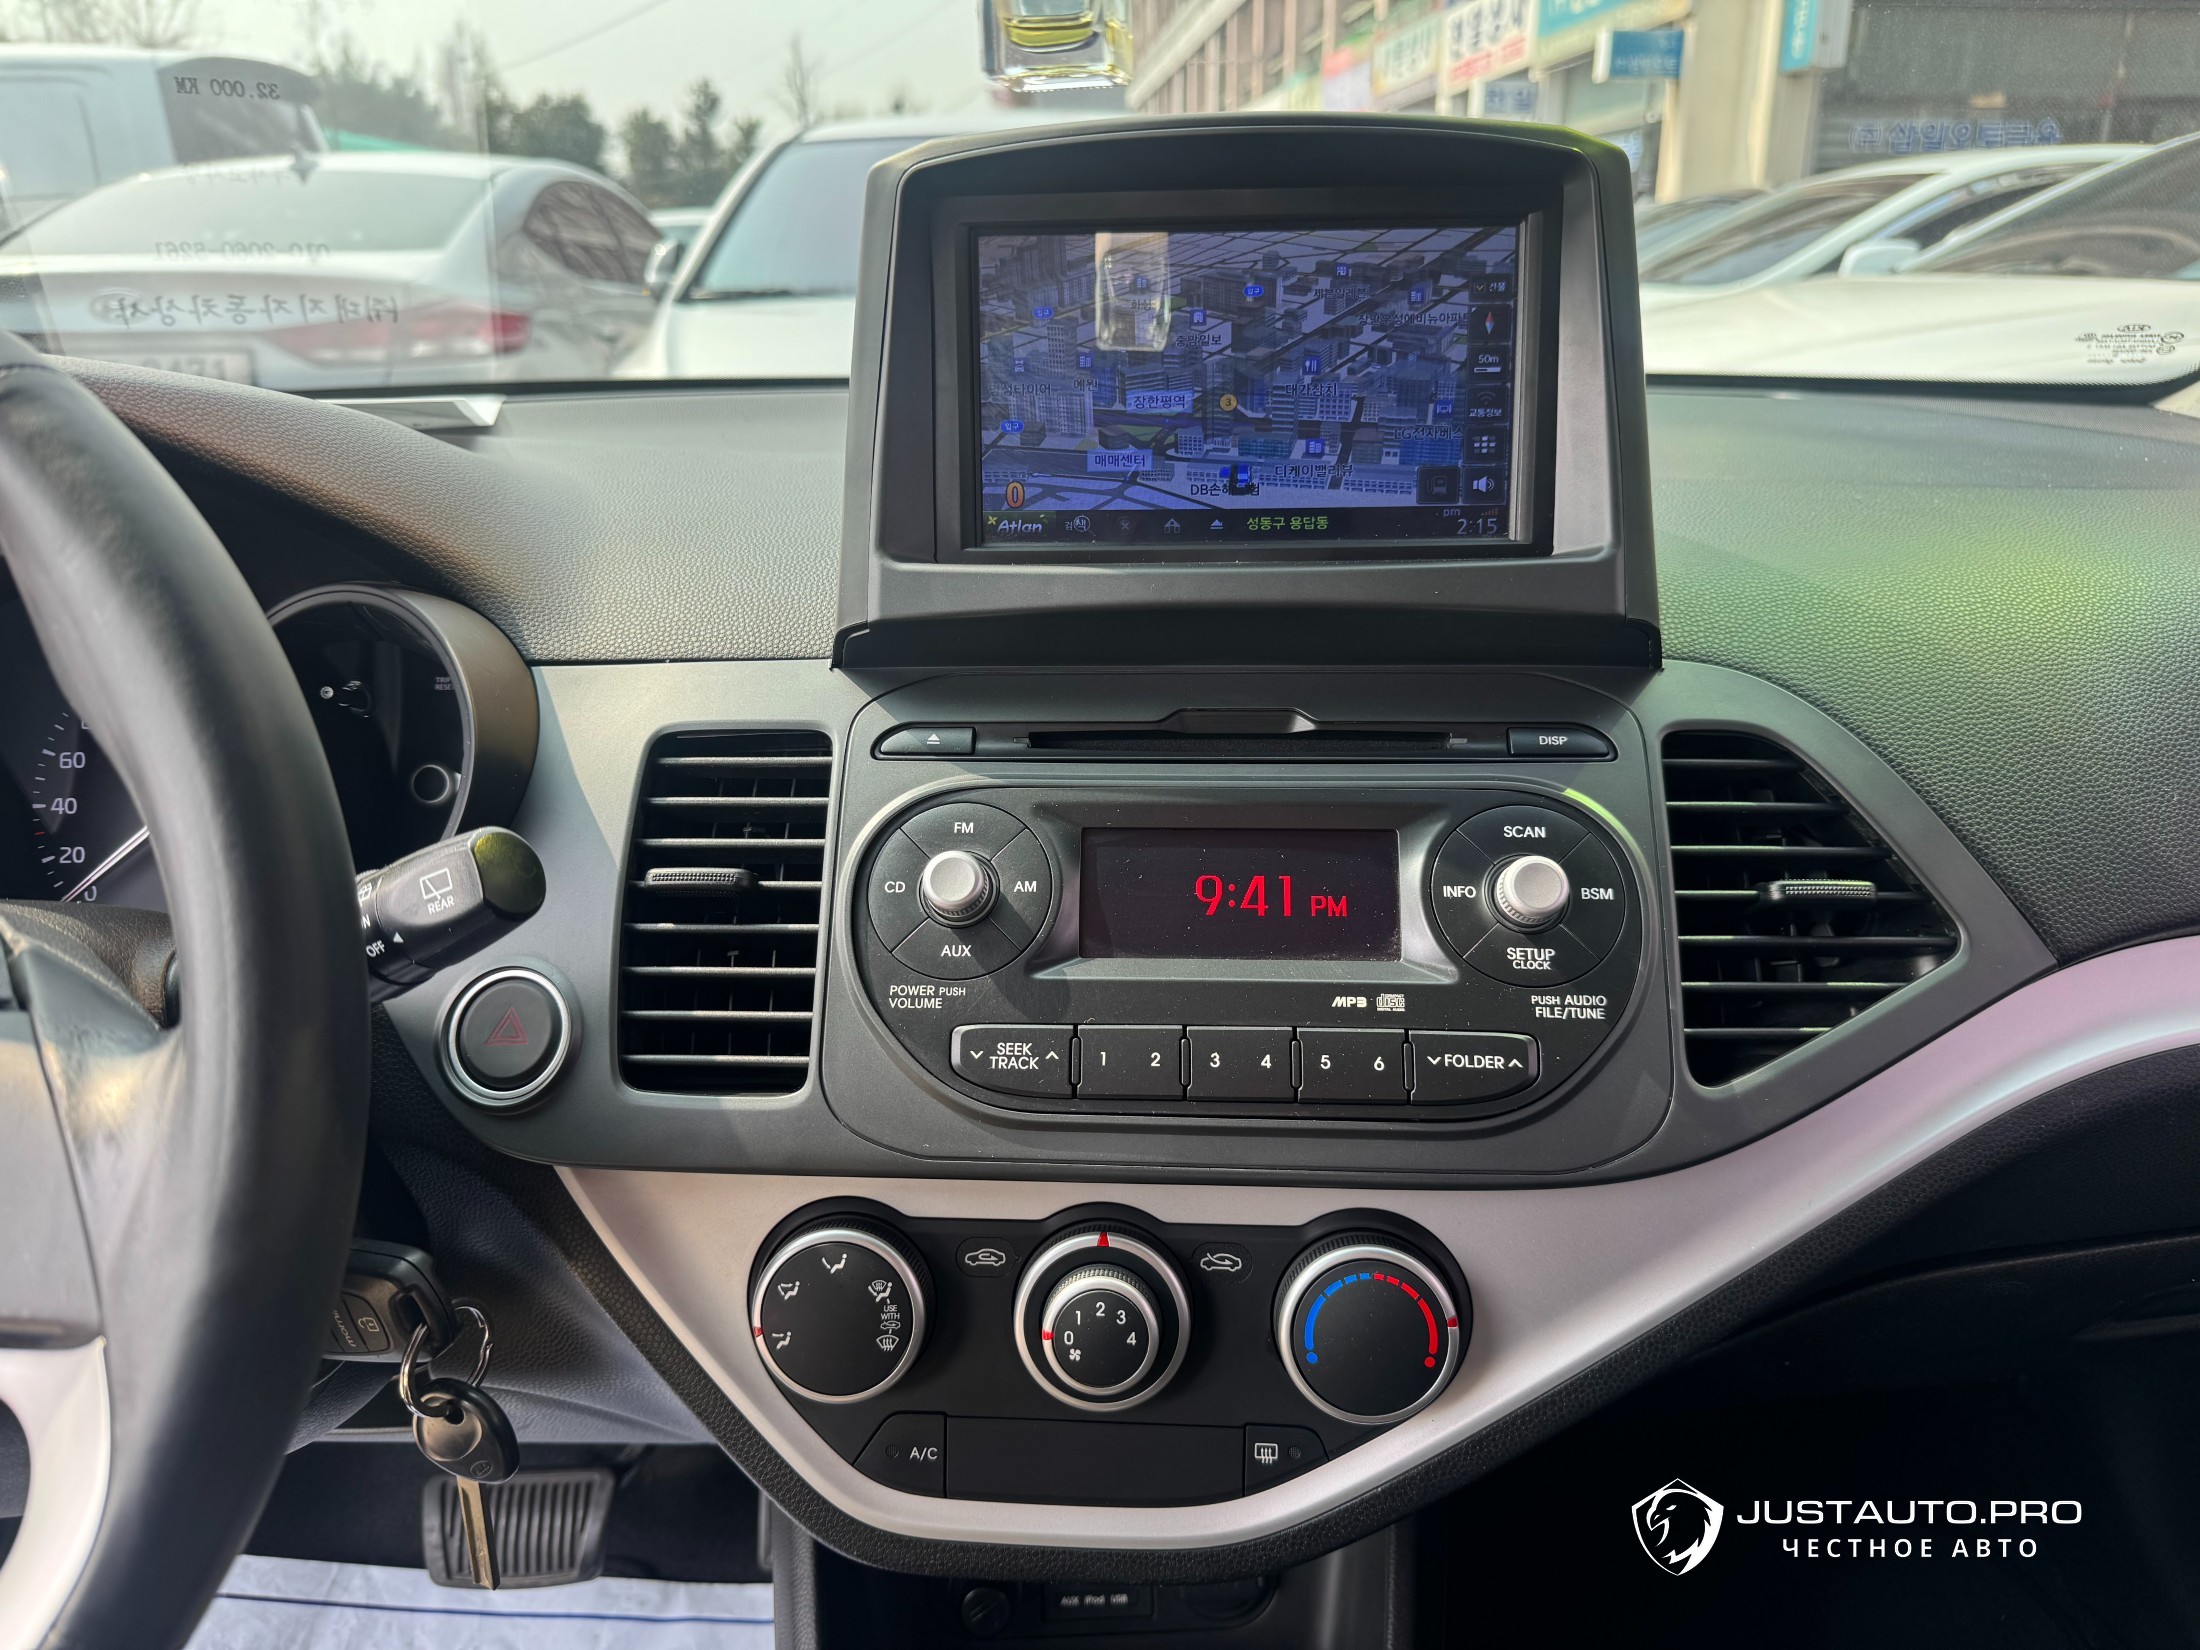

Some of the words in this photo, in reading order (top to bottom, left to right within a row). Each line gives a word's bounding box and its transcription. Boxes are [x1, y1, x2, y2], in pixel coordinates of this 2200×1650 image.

[1478, 354, 1499, 365] 50m
[1285, 382, 1337, 397] 대가참치
[1133, 394, 1186, 410] 장한평역
[1094, 453, 1146, 468] 매매센터
[1005, 480, 1025, 509] 0
[1442, 506, 1461, 518] pm
[997, 518, 1043, 534] Atlan
[1246, 516, 1286, 531] 성동구
[1290, 516, 1329, 531] 용답동
[1456, 518, 1498, 535] 2:15
[1538, 735, 1568, 746] DISP
[59, 751, 86, 769] 60
[50, 797, 78, 815] 40
[953, 821, 975, 834] FM
[1503, 825, 1546, 839] SCAN
[59, 846, 86, 864] 20
[884, 880, 906, 894] CD
[1013, 880, 1037, 893] AM
[1442, 885, 1477, 898] INFO
[1580, 887, 1614, 900] BSM
[1195, 874, 1293, 917] 9:41
[1310, 895, 1348, 917] PM
[427, 894, 456, 916] REAR
[365, 939, 386, 958] OFF
[940, 944, 972, 957] AUX
[1506, 947, 1556, 962] SETUP
[1512, 960, 1551, 971] CLOCK
[889, 985, 935, 997] POWER
[939, 987, 966, 997] PUSH
[888, 997, 943, 1010] VOLUME
[1331, 996, 1367, 1008] MP3
[1530, 995, 1560, 1005] PUSH
[1564, 994, 1606, 1007] AUDIO
[1535, 1006, 1606, 1020] FILE/TUNE
[996, 1042, 1033, 1056] SEEK
[989, 1056, 1039, 1070] TRACK
[1100, 1051, 1107, 1066] 1
[1150, 1052, 1161, 1067] 2
[1209, 1052, 1221, 1068] 3
[1260, 1054, 1272, 1068] 4
[1320, 1054, 1331, 1069] 5
[1374, 1056, 1385, 1071] 6
[1444, 1053, 1505, 1069] FOLDER
[883, 1304, 898, 1312] USE
[1095, 1301, 1106, 1317] 2
[880, 1312, 900, 1320] WITH
[1075, 1310, 1082, 1325] 1
[1115, 1310, 1127, 1325] 3
[1064, 1330, 1074, 1346] 0
[1126, 1331, 1137, 1346] 4
[909, 1445, 938, 1461] A/C
